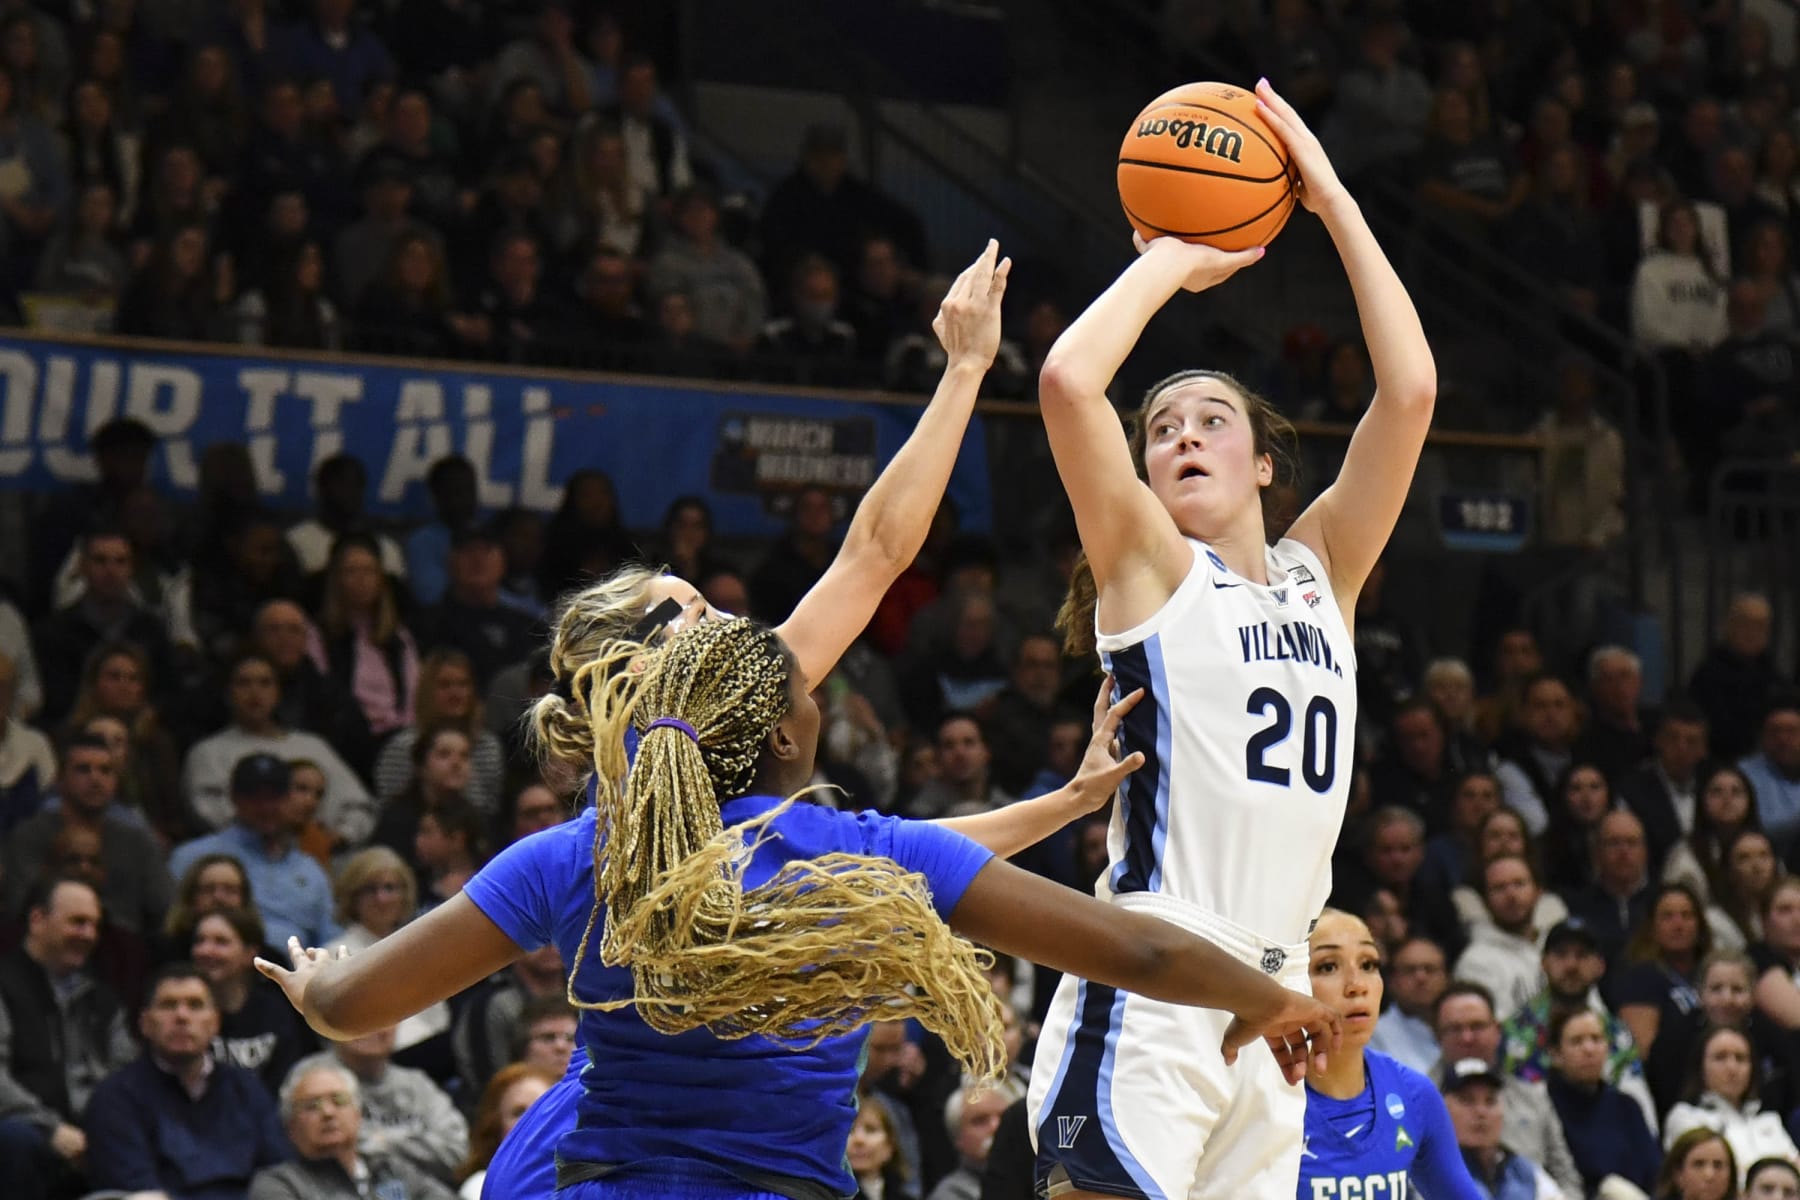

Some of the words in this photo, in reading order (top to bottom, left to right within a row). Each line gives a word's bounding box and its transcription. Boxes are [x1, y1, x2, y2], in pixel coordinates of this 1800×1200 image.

[1137, 118, 1244, 164] Wilson
[239, 369, 363, 494] IT
[379, 380, 564, 512] ALL
[1246, 687, 1338, 794] 20
[1057, 1115, 1087, 1148] V
